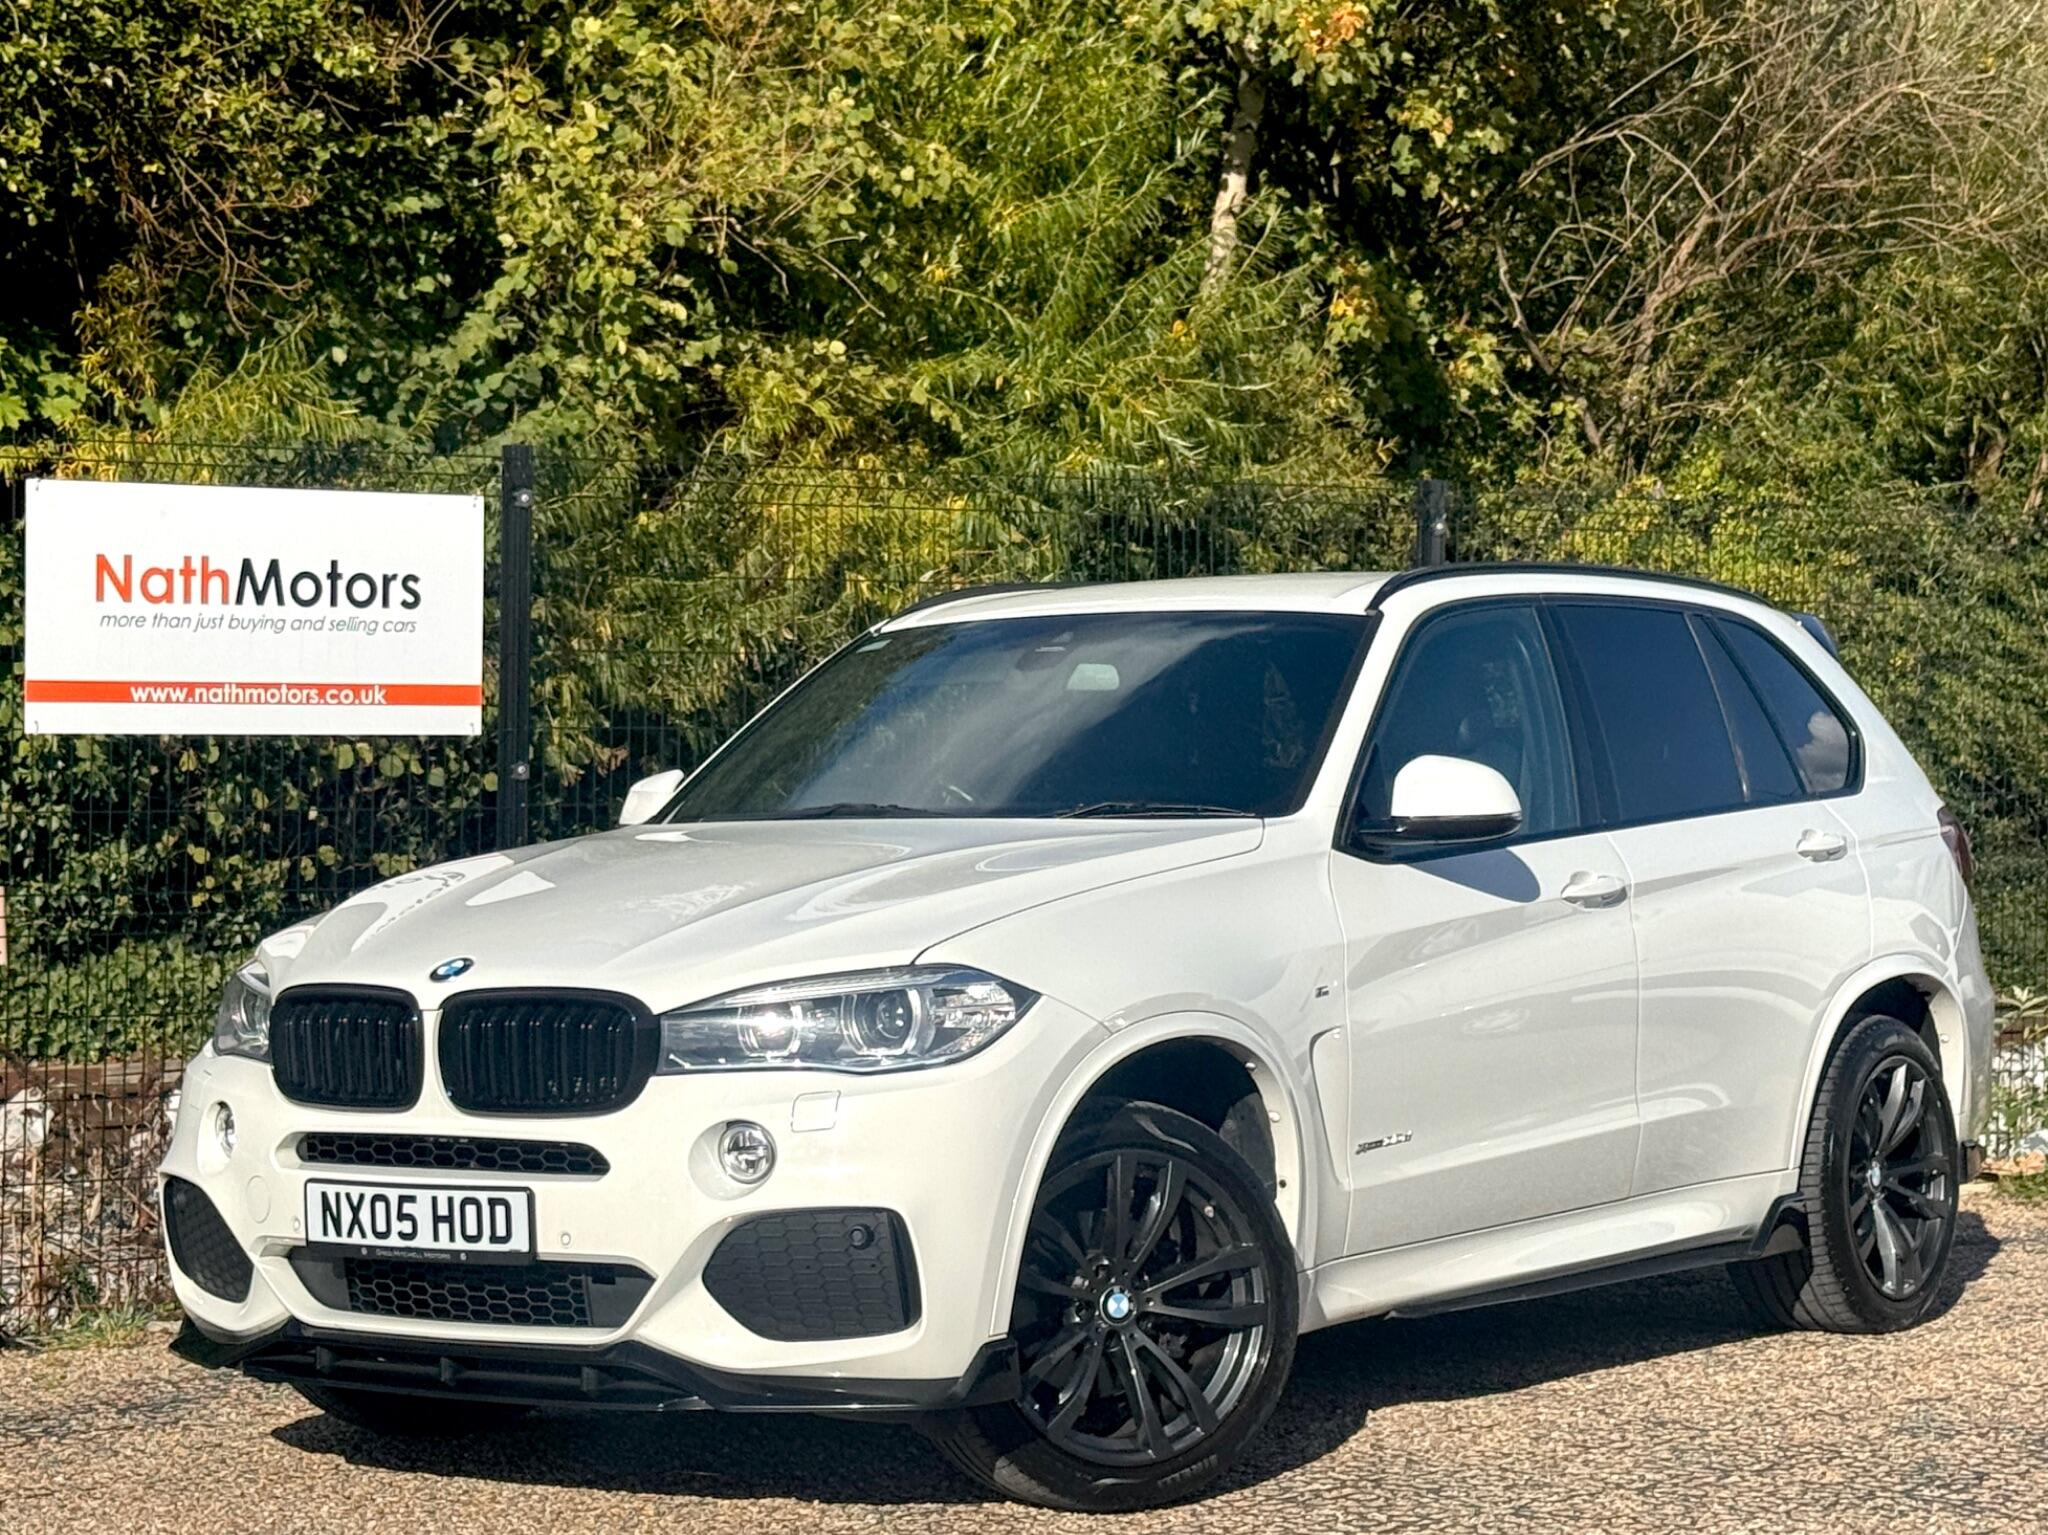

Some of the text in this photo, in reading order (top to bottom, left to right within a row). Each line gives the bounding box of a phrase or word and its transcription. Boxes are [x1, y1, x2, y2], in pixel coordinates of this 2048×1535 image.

[95, 553, 422, 610] NathMotors
[99, 612, 417, 636] more than just buying and selling cars
[130, 682, 388, 706] www.nathmotors.co.uk
[321, 1190, 514, 1245] NX05 HOD
